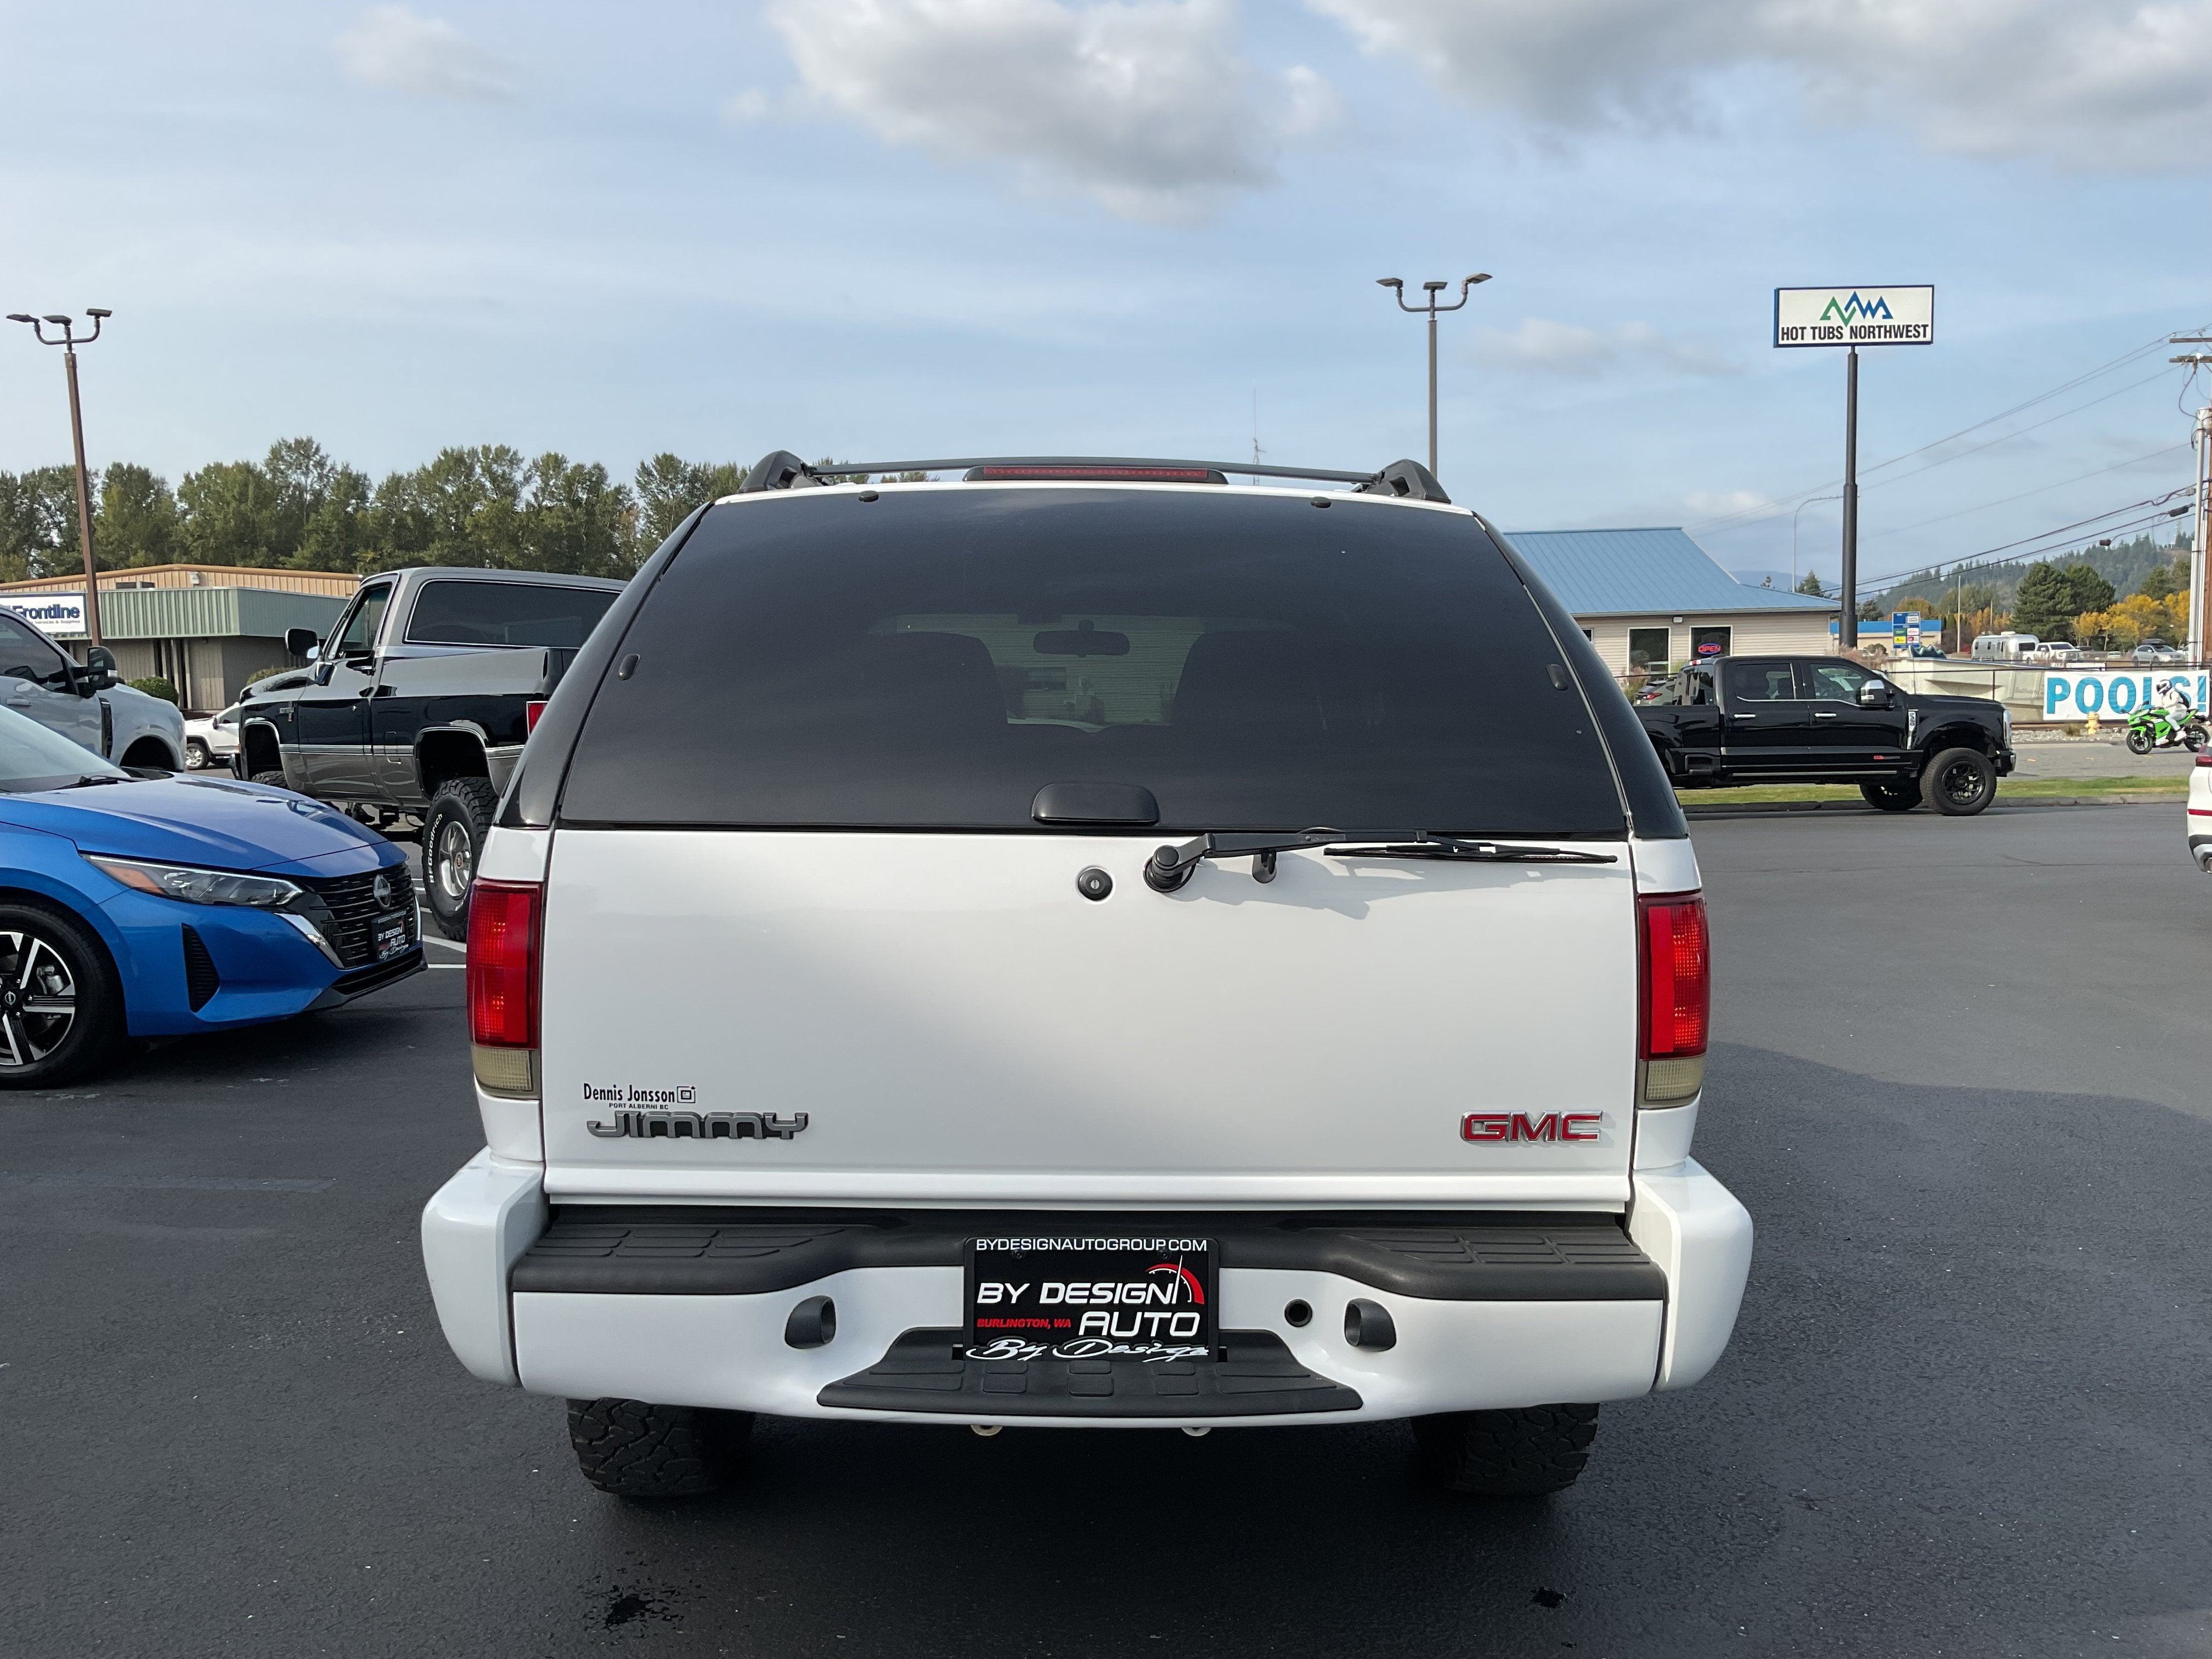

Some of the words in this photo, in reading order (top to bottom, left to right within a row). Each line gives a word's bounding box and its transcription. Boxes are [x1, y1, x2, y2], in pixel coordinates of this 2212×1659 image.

[1781, 326, 1807, 341] HOT
[1810, 325, 1844, 341] TUBS
[1849, 324, 1929, 340] NORTHWEST
[386, 926, 403, 939] DESIGN
[390, 934, 405, 947] AUTO
[584, 1083, 623, 1101] Dennis
[628, 1085, 675, 1102] Jonsson
[1459, 1110, 1603, 1142] GMC
[976, 1238, 1207, 1251] BYDESIGNAUTOGROUP.COM
[977, 1283, 1030, 1304] BY
[1039, 1283, 1174, 1304] DESIGN
[977, 1318, 1051, 1330] BURLINGTON,
[1053, 1319, 1071, 1328] WA
[1078, 1311, 1200, 1337] AUTO
[966, 1339, 1047, 1361] By
[1052, 1339, 1209, 1363] Design
